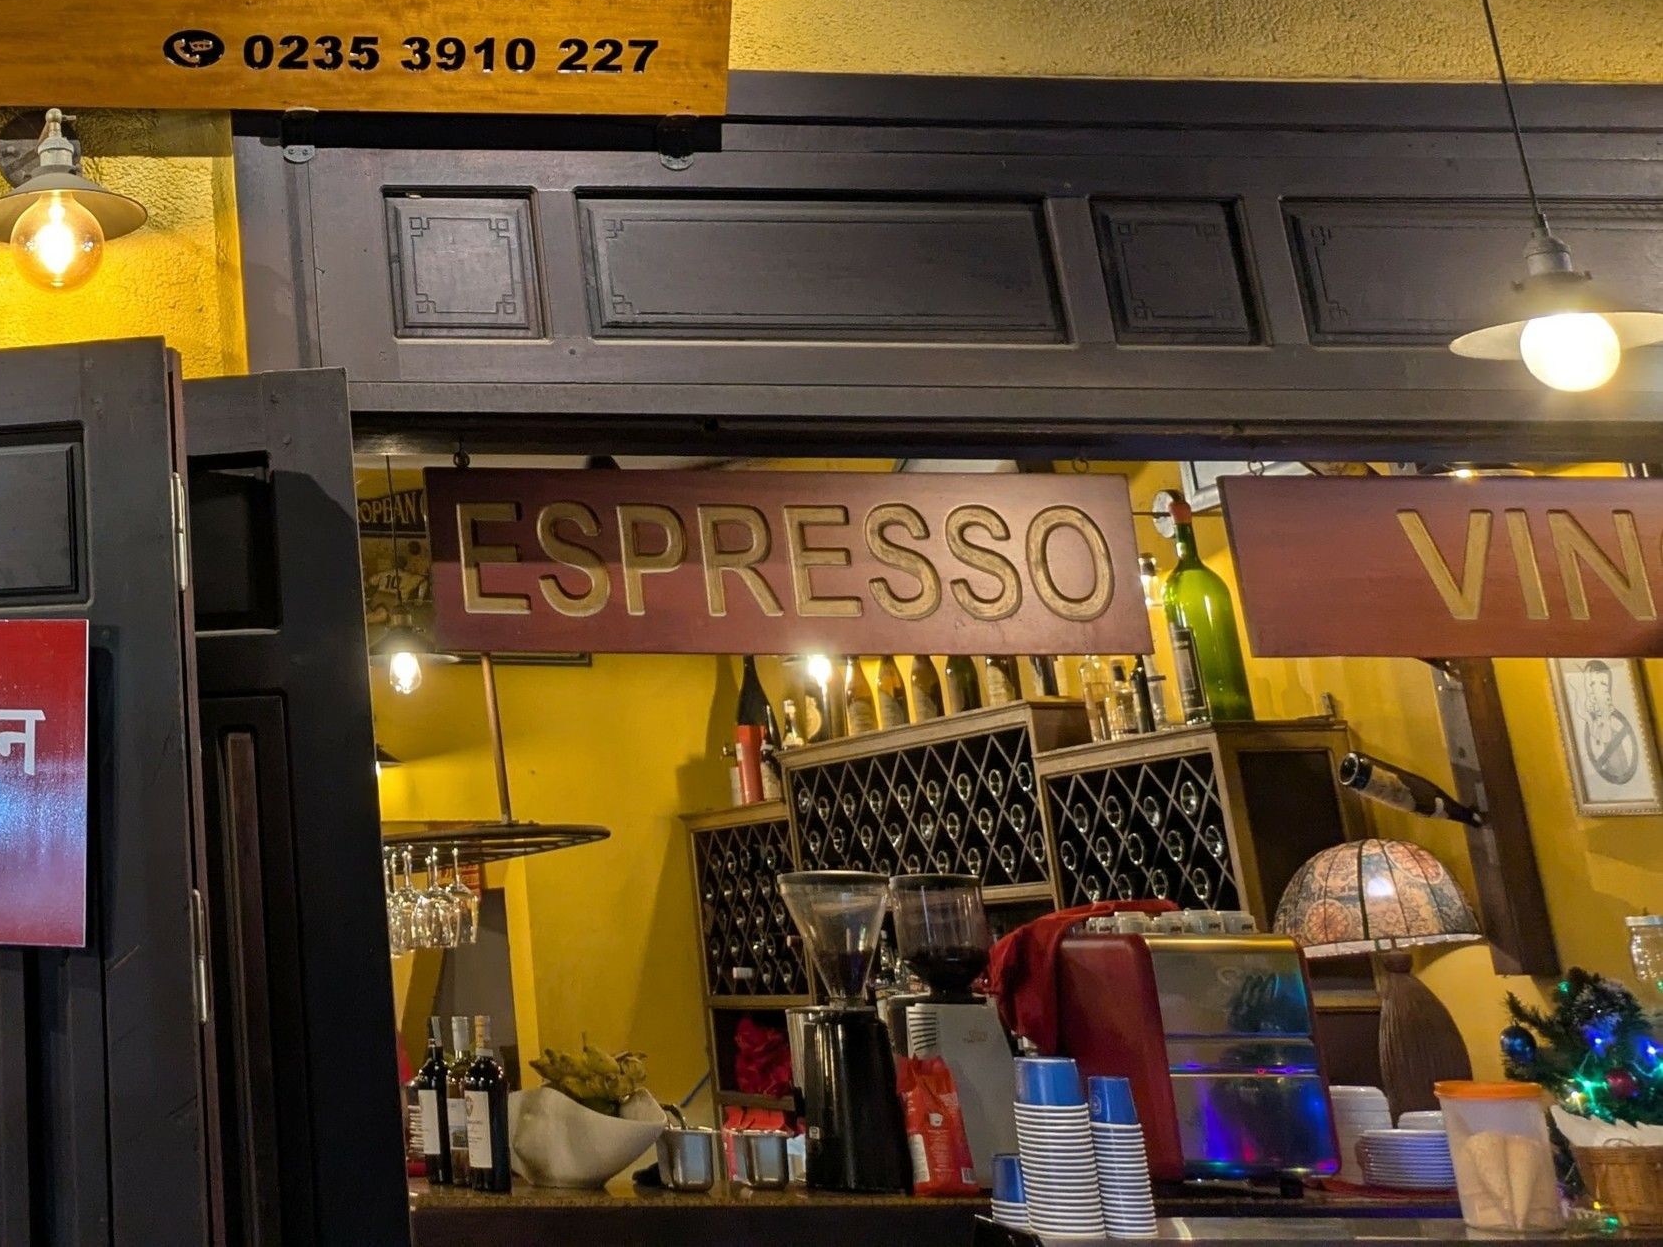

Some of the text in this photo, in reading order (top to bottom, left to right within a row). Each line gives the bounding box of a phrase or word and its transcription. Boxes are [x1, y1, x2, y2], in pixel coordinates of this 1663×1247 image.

[243, 35, 659, 74] 0235 3910 227
[358, 492, 417, 524] OPEAN
[455, 500, 1116, 622] ESPRESSO
[1396, 508, 1663, 621] VIN
